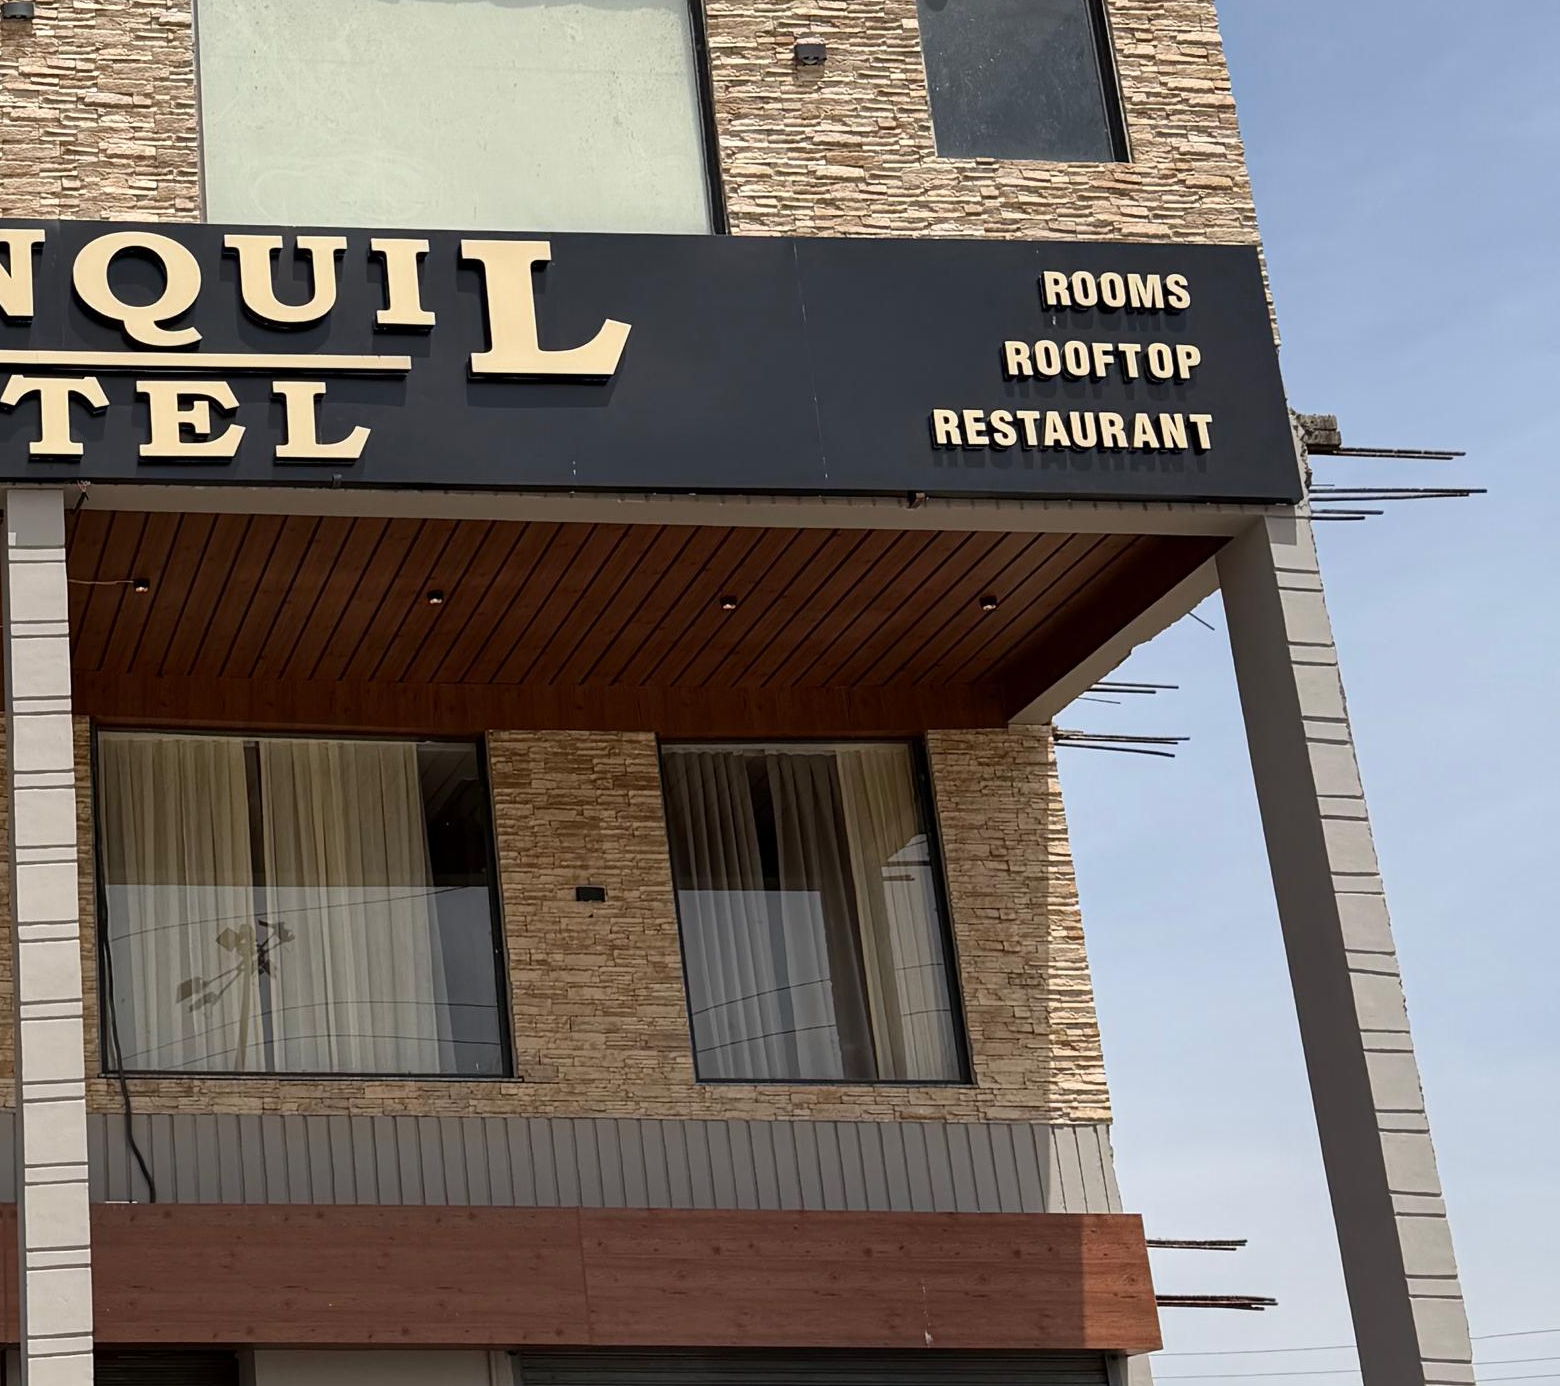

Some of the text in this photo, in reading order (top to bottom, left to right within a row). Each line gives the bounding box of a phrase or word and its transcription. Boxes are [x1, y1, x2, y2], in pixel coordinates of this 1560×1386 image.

[1041, 270, 1191, 310] ROOMS
[1003, 339, 1202, 380] ROOFTOP
[931, 408, 1214, 451] RESTAURANT
